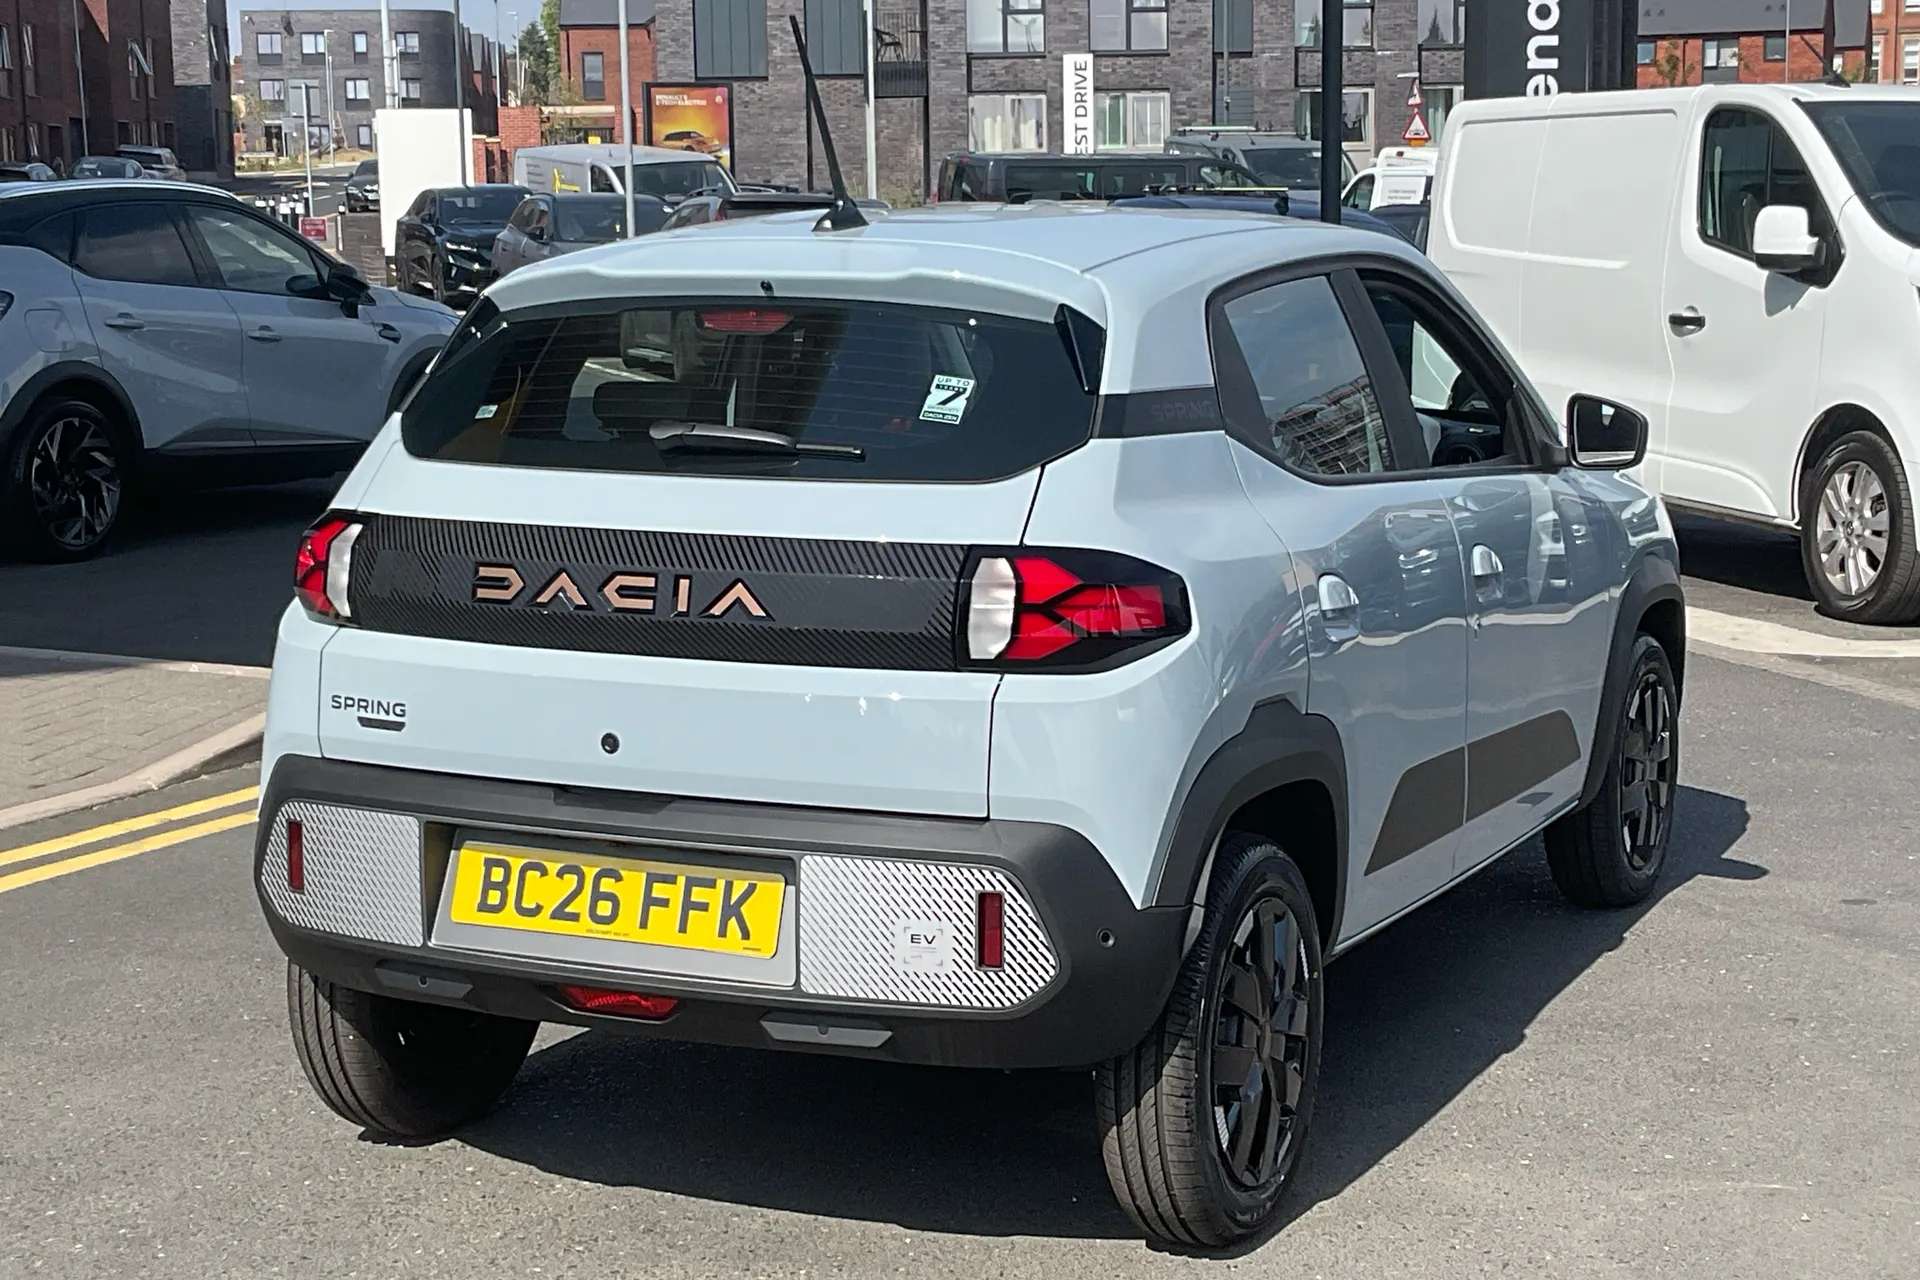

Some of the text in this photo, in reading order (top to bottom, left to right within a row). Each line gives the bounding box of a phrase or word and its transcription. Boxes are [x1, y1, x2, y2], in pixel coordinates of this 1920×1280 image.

[1074, 60, 1088, 118] DRIVE
[956, 379, 970, 387] TO
[472, 564, 771, 619] DACIA
[331, 694, 406, 718] SPRING
[477, 857, 758, 941] BC26 FFK
[910, 933, 936, 945] EV
